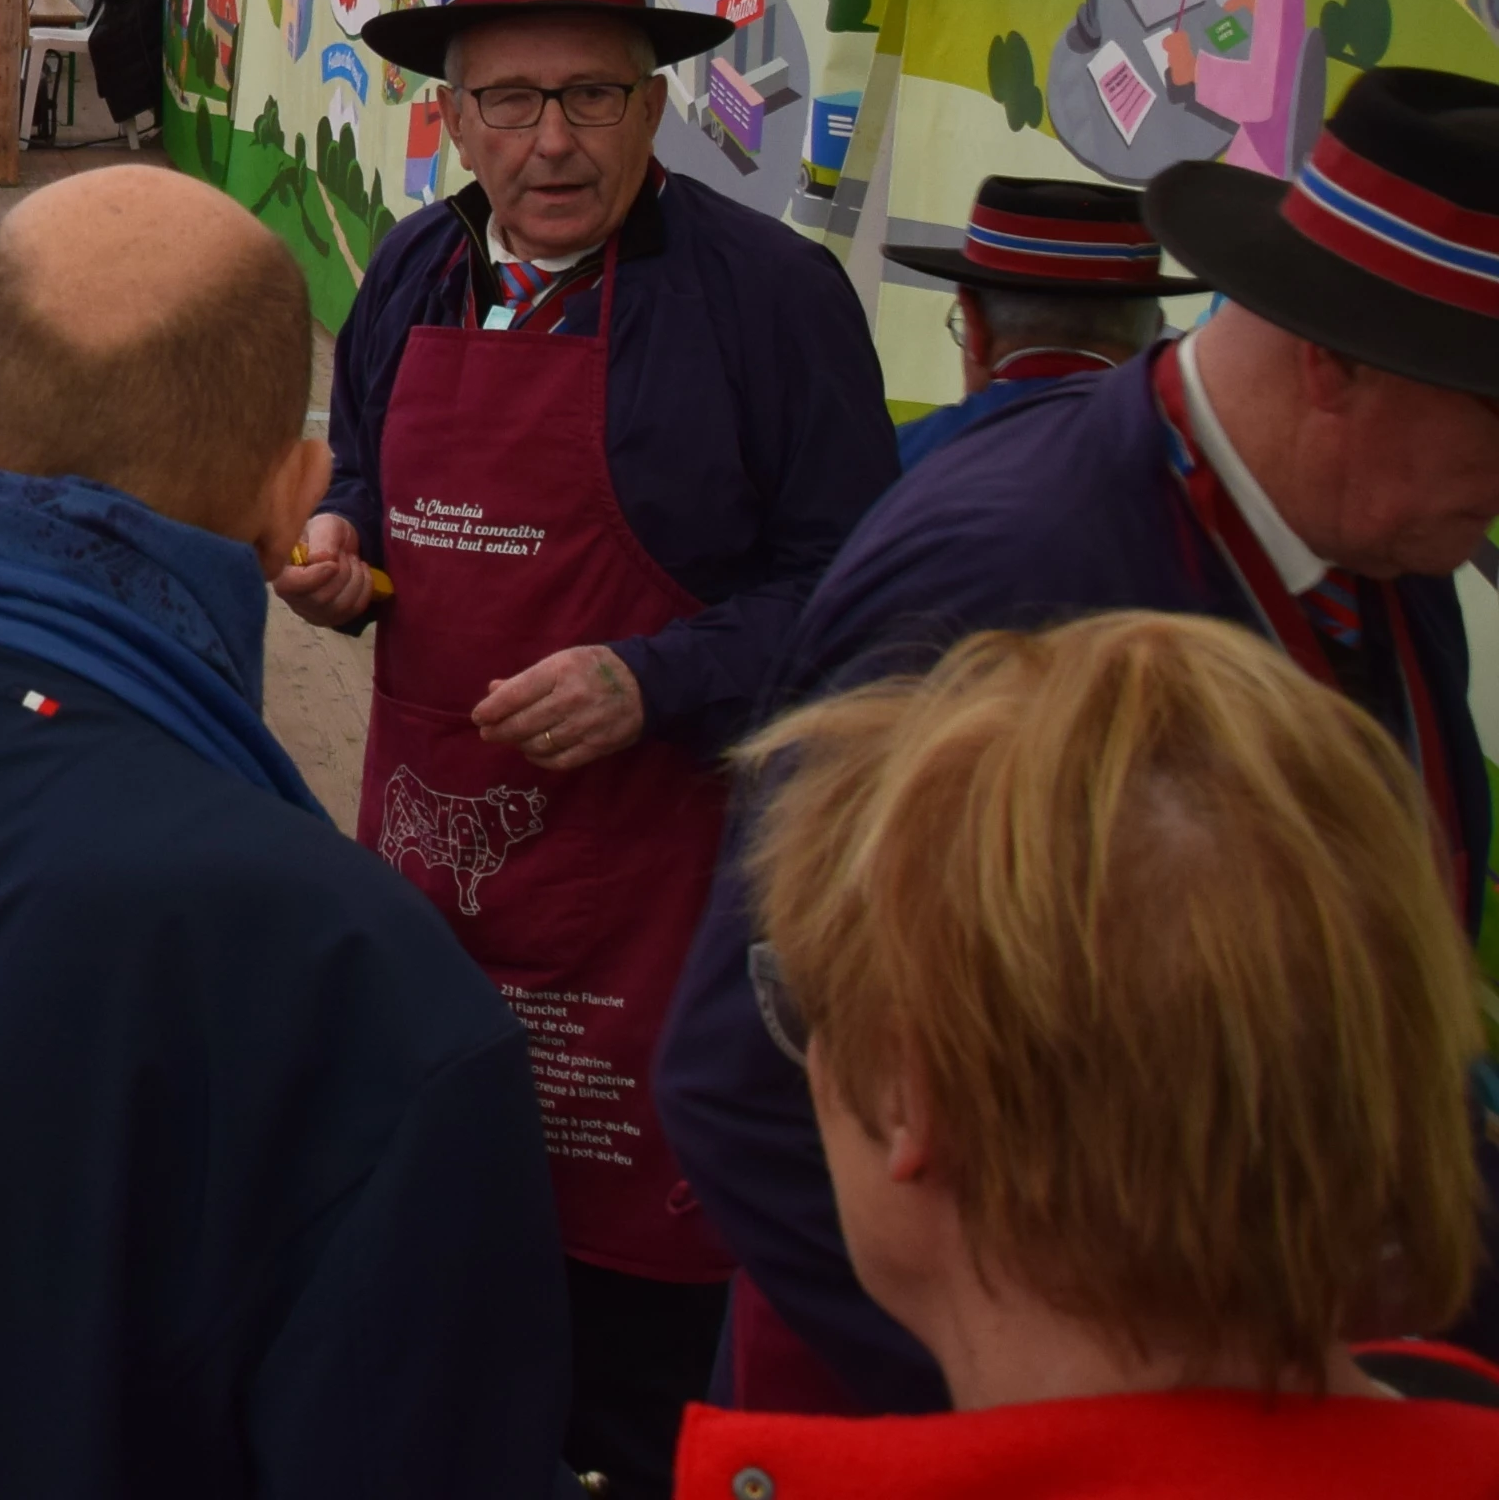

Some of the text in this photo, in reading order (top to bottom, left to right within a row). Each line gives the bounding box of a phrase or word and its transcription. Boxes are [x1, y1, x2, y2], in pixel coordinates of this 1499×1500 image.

[414, 497, 483, 519] Le Charolais
[420, 516, 427, 528] à
[427, 516, 460, 534] mieux
[463, 519, 472, 535] le
[474, 525, 546, 540] connaître
[406, 528, 454, 548] l'apprécier
[456, 537, 482, 552] tout
[485, 540, 528, 556] entier
[532, 541, 541, 556] !
[501, 983, 624, 1008] 23 Bavette de Flanchet
[515, 1001, 568, 1018] Flanchet
[542, 1019, 557, 1033] de
[559, 1022, 585, 1036] côte
[529, 1048, 612, 1070] ilieu de poitrine
[546, 1066, 571, 1080] bout
[571, 1070, 585, 1082] de
[587, 1073, 636, 1088] poitrine
[534, 1081, 620, 1101] creuse à Bifteck
[561, 1129, 569, 1141] à
[571, 1131, 612, 1146] bifteck
[570, 1116, 578, 1128] à
[580, 1118, 641, 1137] pot-au-feu
[563, 1143, 569, 1155] à
[572, 1147, 633, 1166] pot-au-feu
